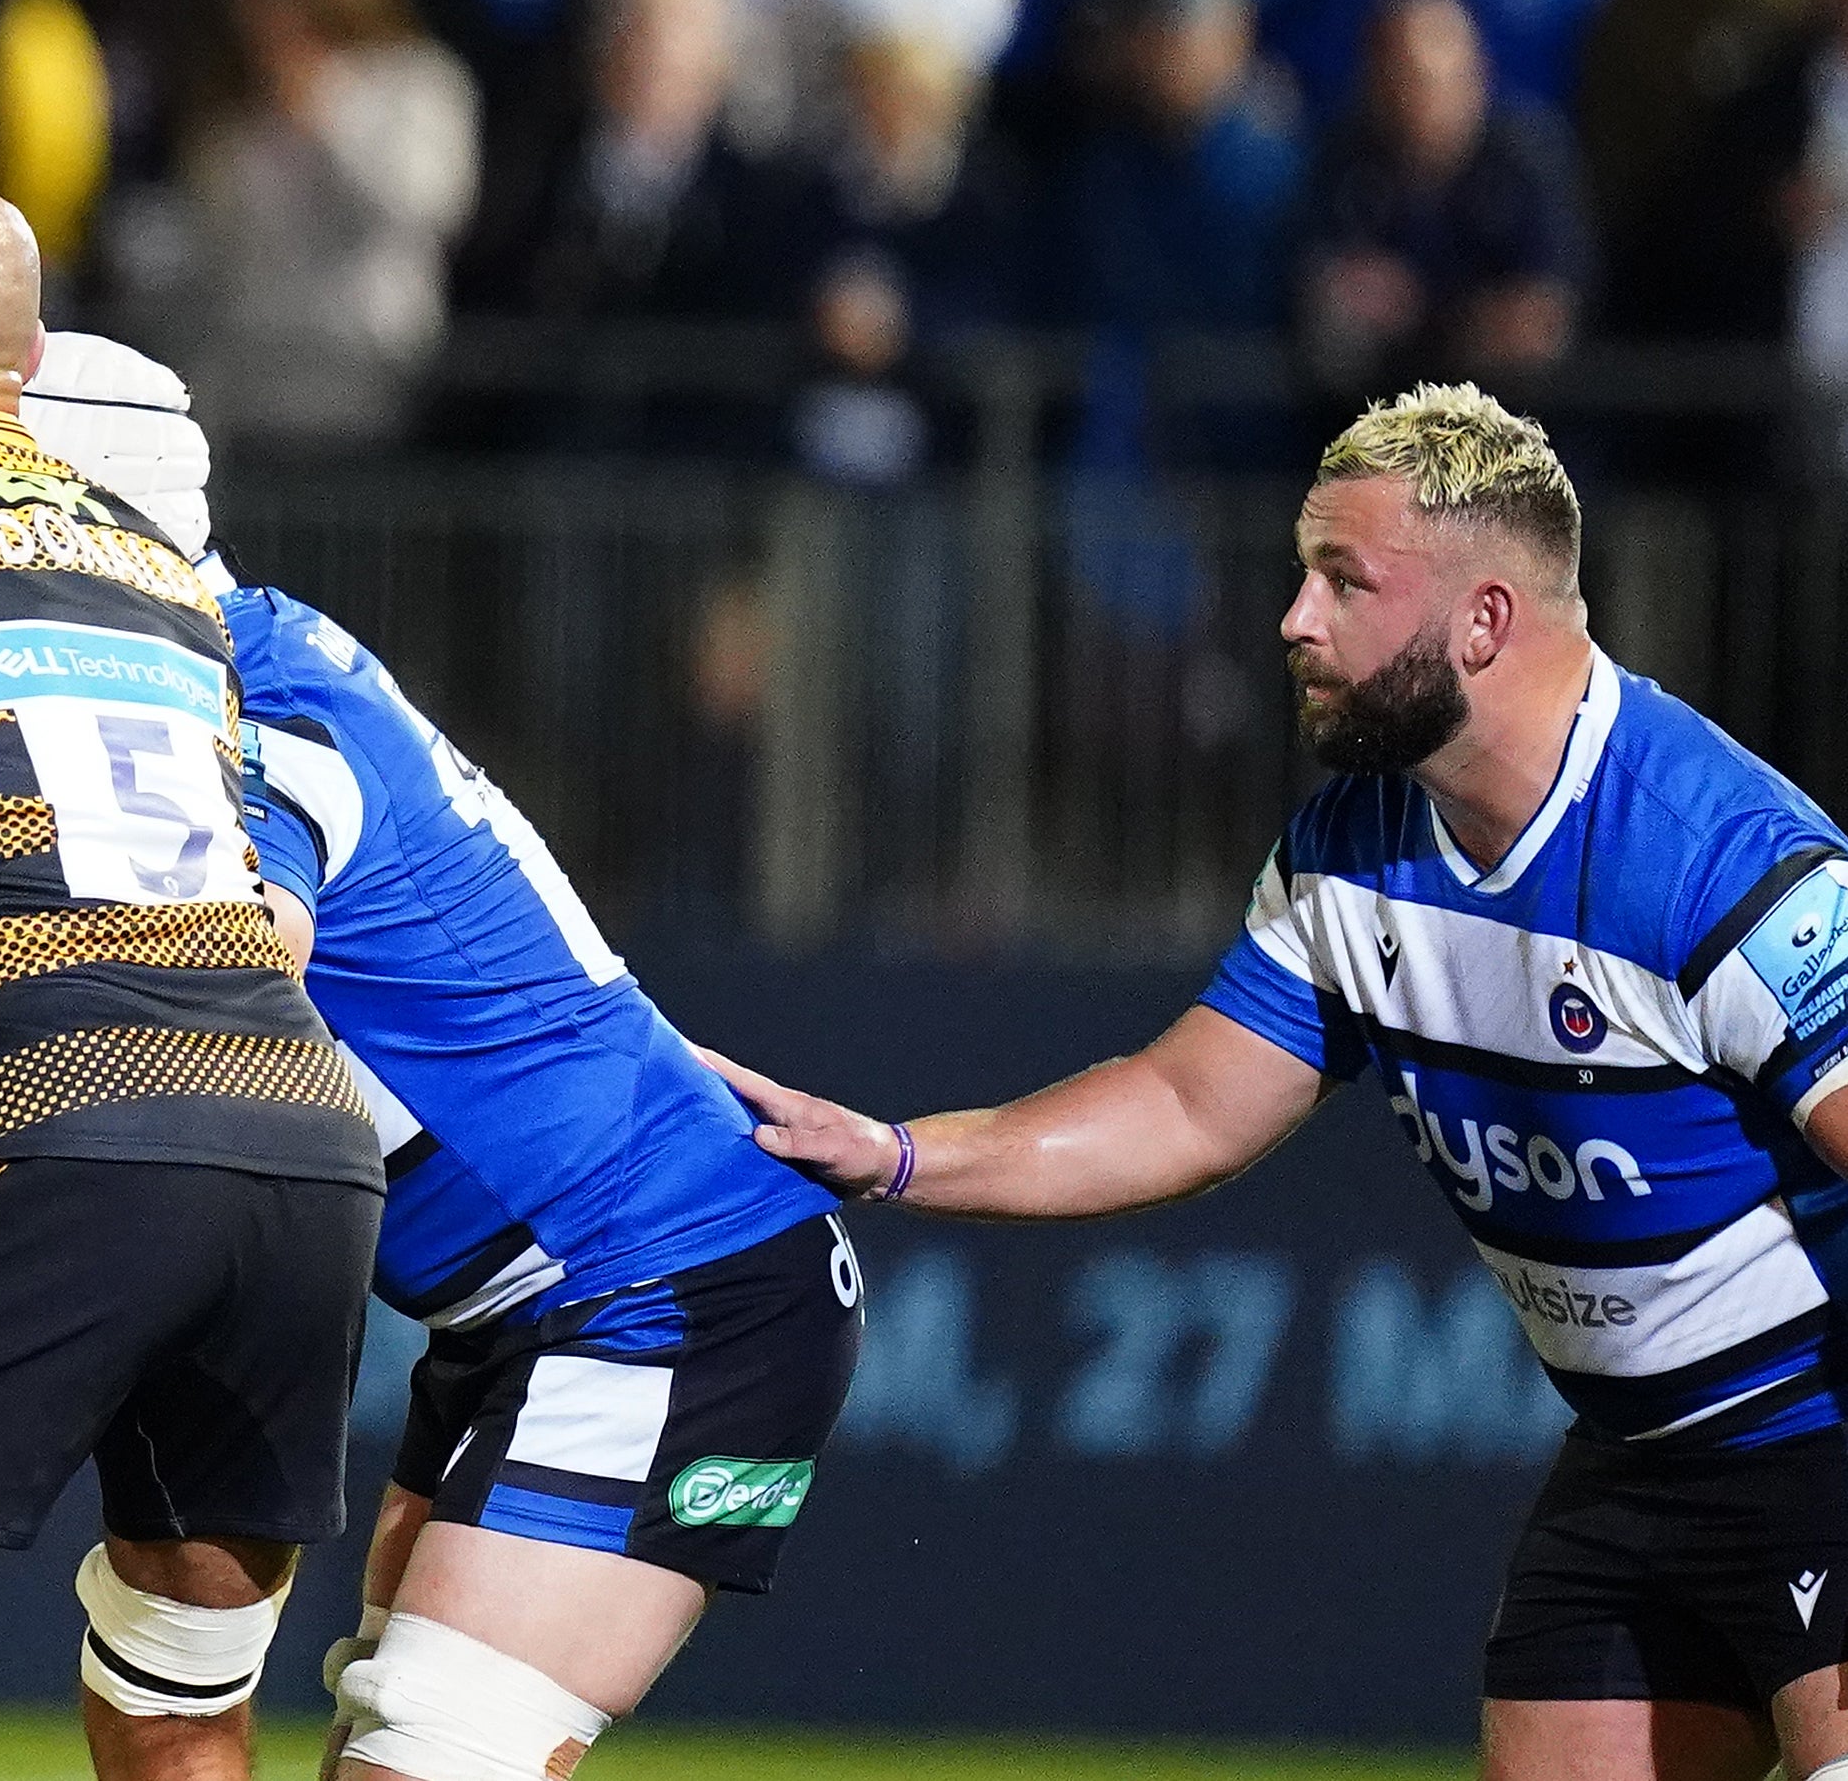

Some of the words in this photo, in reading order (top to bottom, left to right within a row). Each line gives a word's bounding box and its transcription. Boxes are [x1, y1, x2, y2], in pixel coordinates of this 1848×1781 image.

[60, 647, 220, 715] Technologies
[96, 715, 215, 899] 5
[1794, 993, 1847, 1042] RUGBY
